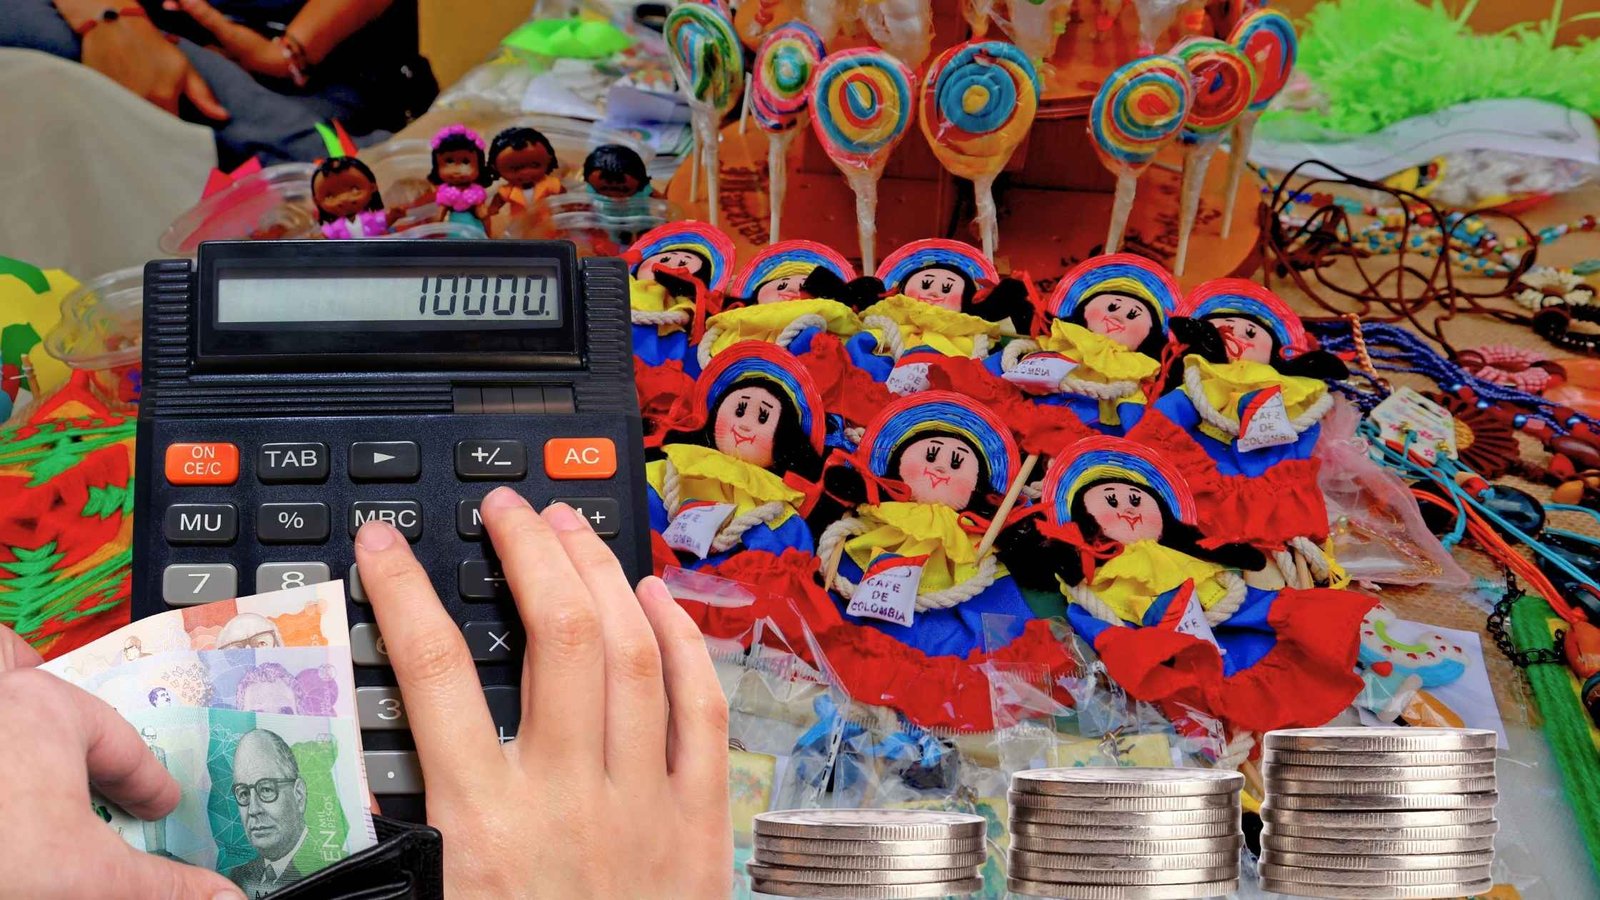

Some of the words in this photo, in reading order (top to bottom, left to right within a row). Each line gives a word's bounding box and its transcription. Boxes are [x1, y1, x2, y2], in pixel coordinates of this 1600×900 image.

[191, 446, 216, 459] ON
[264, 450, 318, 468] TAB
[563, 447, 600, 465] AC
[183, 462, 222, 475] CE/C
[180, 513, 222, 533] MU
[354, 509, 418, 528] MRC
[188, 573, 211, 594] 7
[281, 571, 305, 590] 8
[871, 590, 890, 602] DE
[850, 601, 906, 623] COLOMBIA
[377, 699, 402, 720] 3
